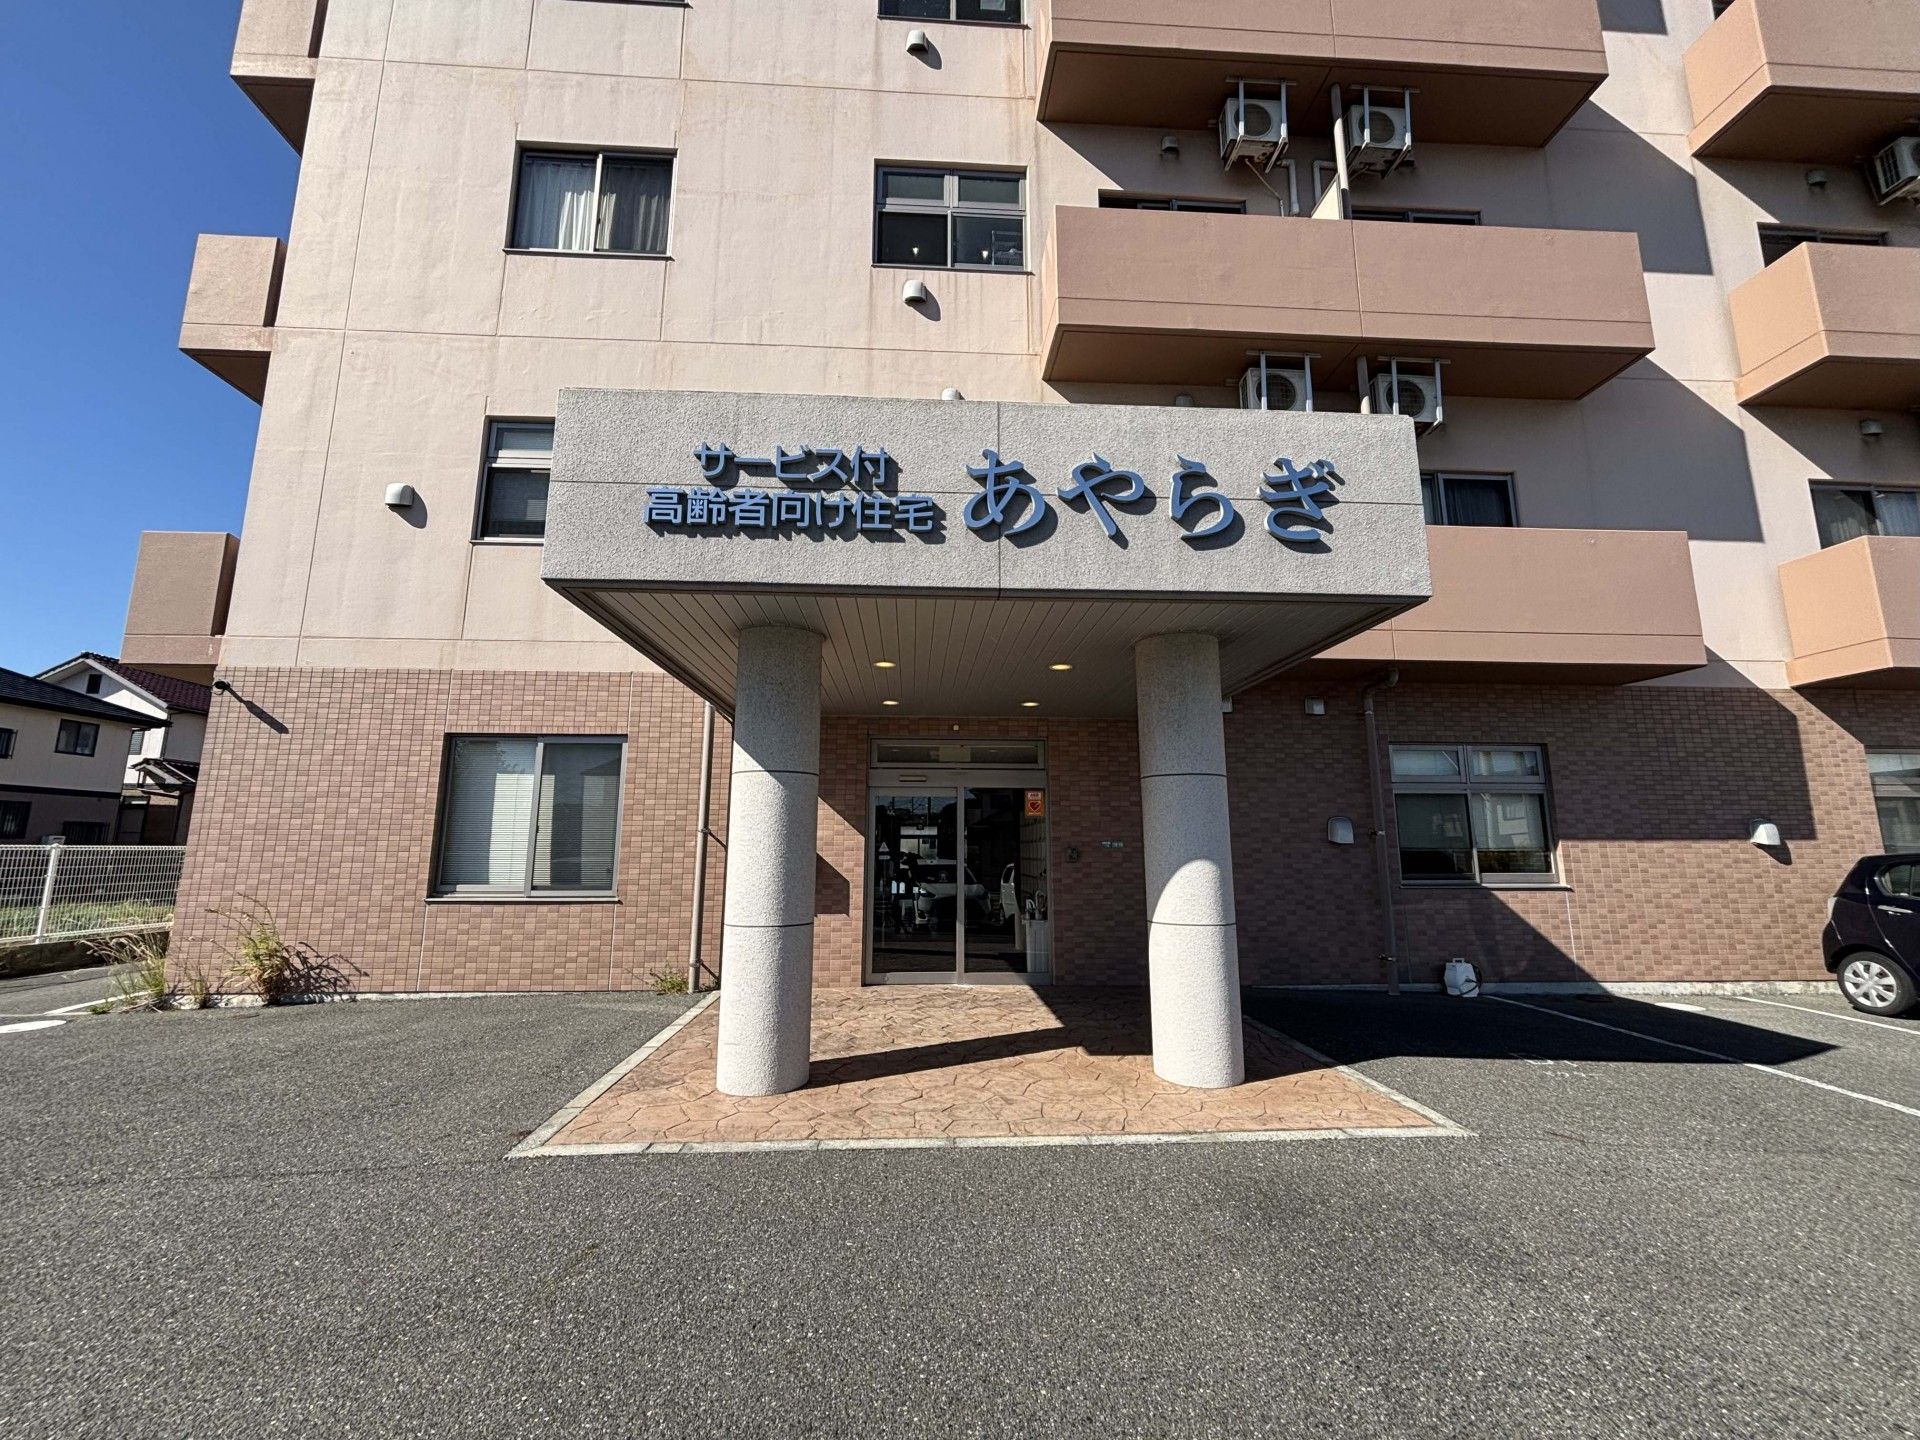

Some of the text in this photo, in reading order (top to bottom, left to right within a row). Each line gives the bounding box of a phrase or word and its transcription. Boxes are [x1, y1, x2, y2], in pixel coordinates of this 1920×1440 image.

[693, 441, 889, 485] サービス付
[643, 485, 935, 533] 高齢者向け住宅
[963, 448, 1335, 543] あやらぎ
